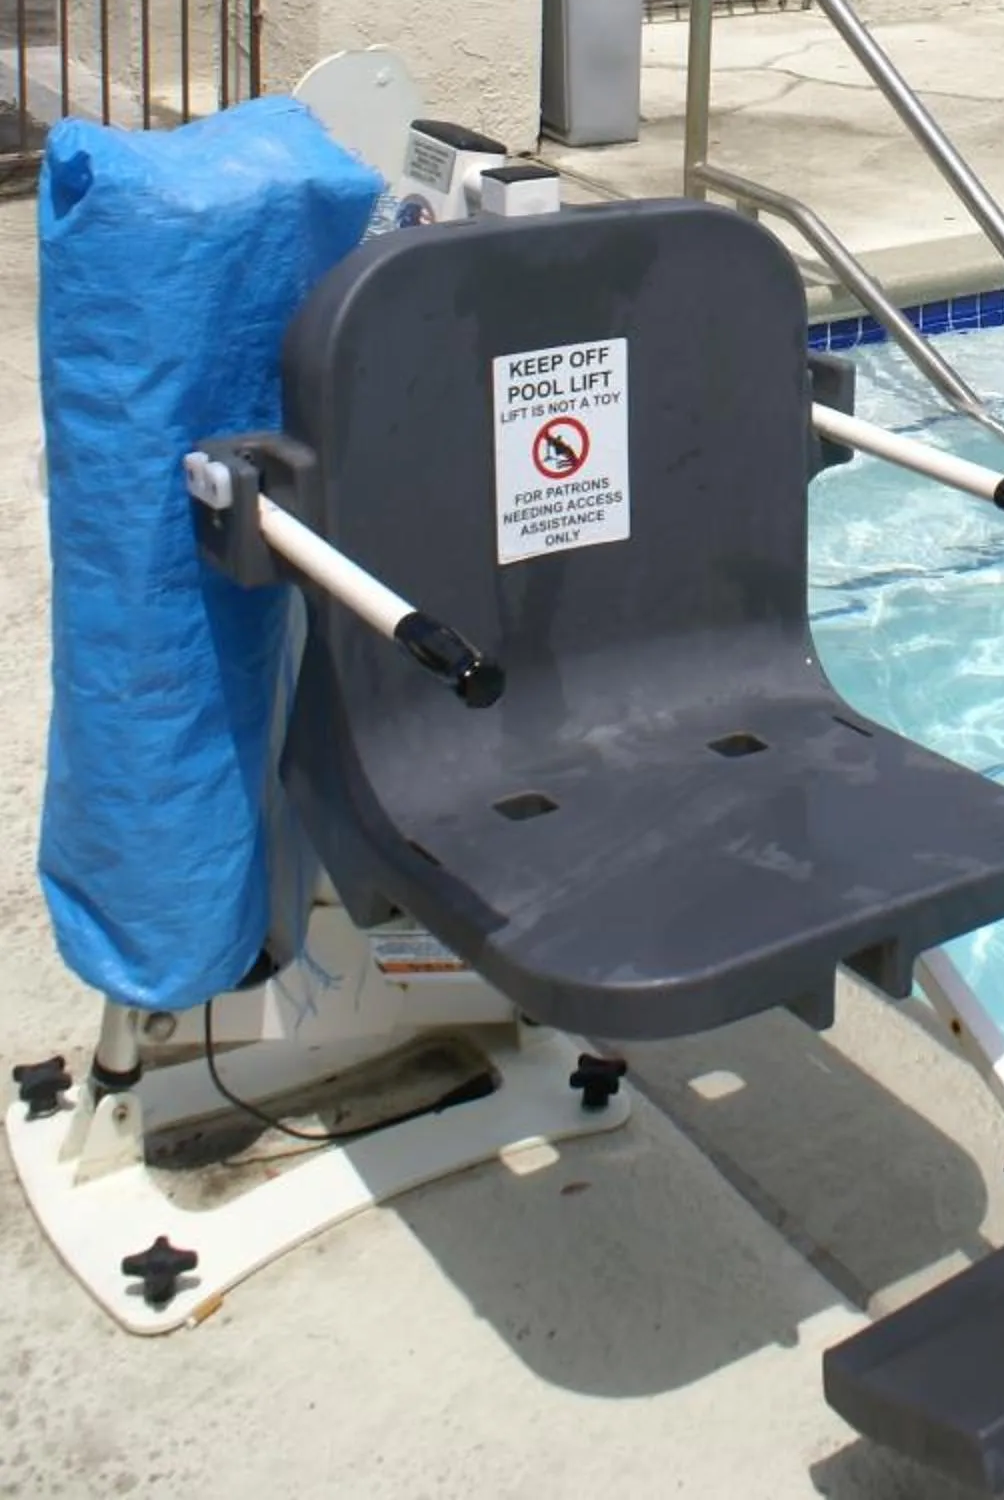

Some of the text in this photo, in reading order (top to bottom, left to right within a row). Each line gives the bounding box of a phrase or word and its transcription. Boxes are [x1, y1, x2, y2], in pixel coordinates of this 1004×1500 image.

[509, 347, 610, 379] KEEP OFF
[508, 370, 612, 404] POOL LIFT
[501, 391, 621, 423] LIFT IS NOT A TOY
[514, 477, 610, 506] FOR PATRONS
[503, 491, 623, 525] NEEDING ACCESS
[520, 510, 605, 536] ASSISTANCE
[545, 530, 581, 547] ONLY
